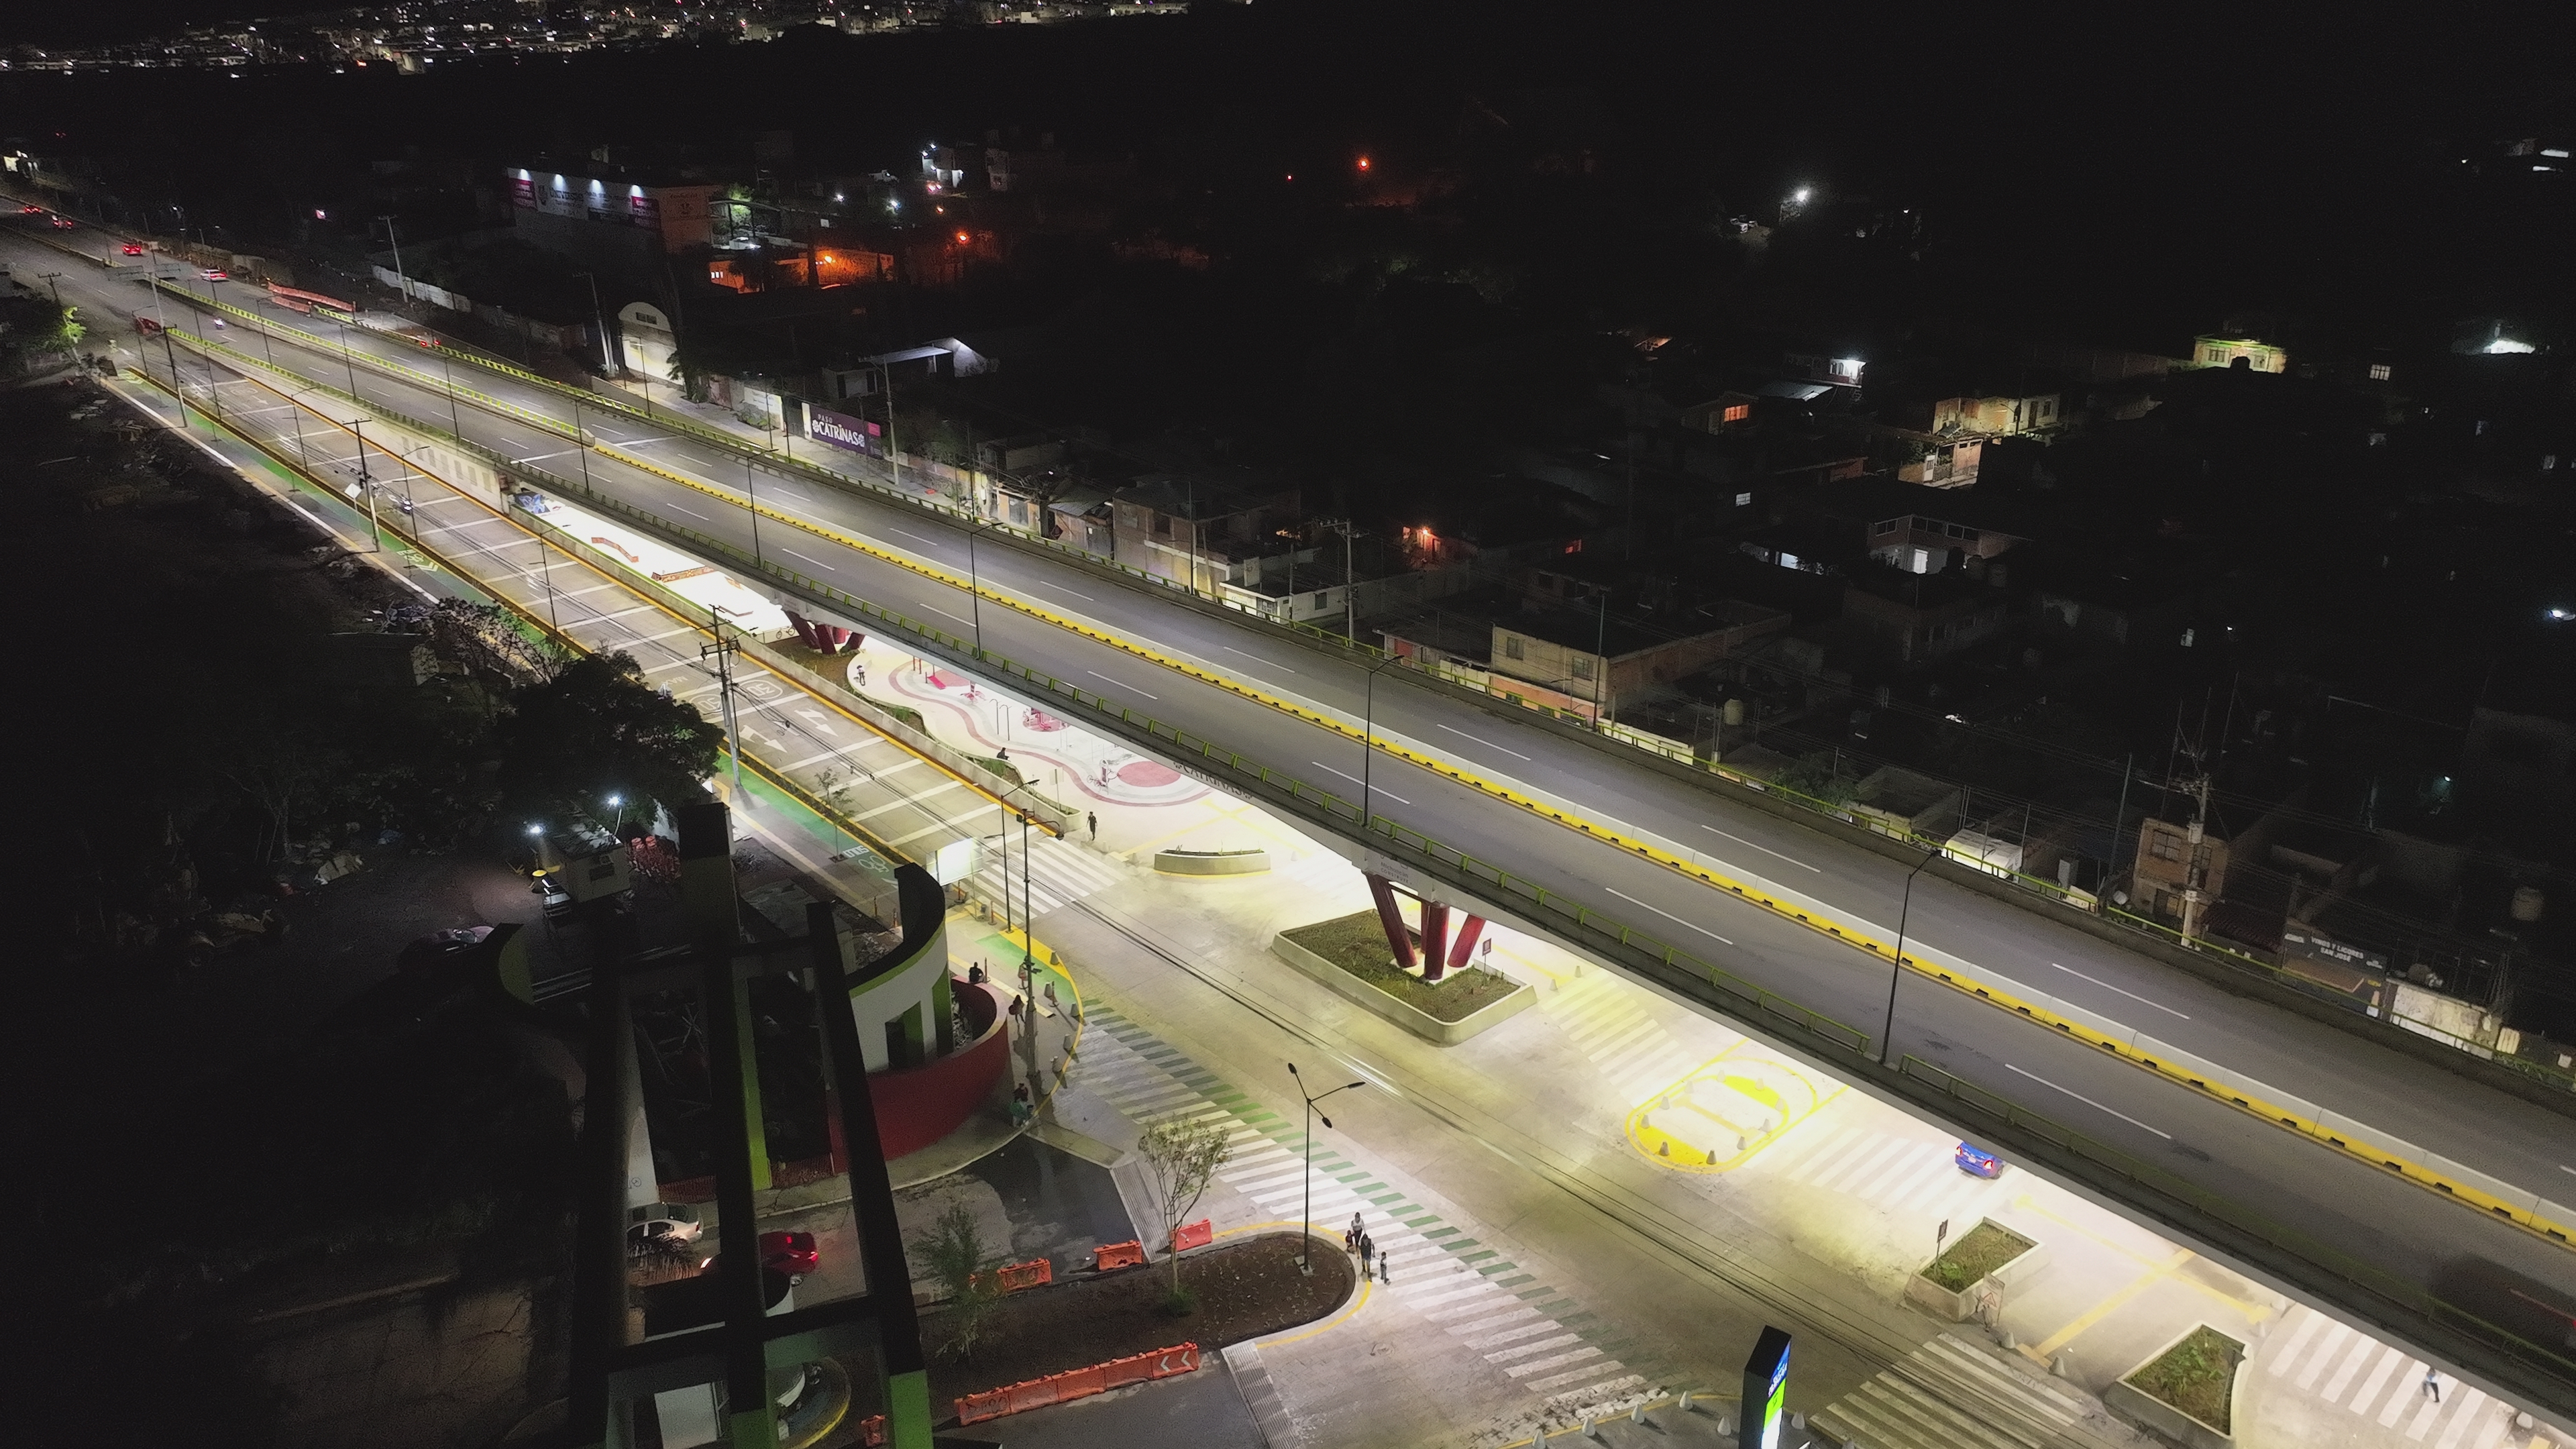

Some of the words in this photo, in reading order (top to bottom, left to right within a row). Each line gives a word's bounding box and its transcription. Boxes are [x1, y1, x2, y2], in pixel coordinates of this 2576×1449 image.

[818, 413, 833, 423] PASO
[746, 684, 775, 696] 30
[2310, 936, 2330, 948] VINOS
[2337, 945, 2364, 959] LICORES
[2320, 947, 2334, 957] SAN
